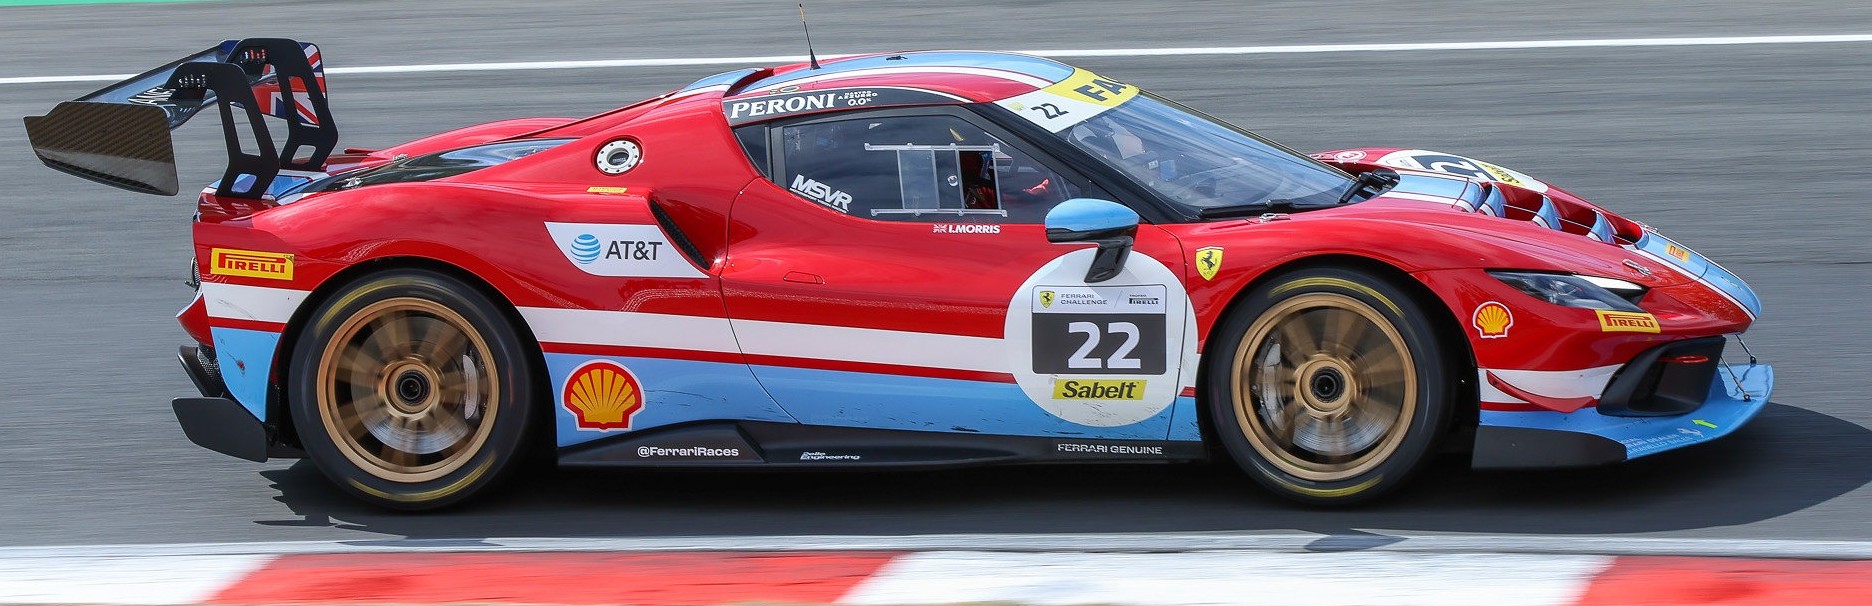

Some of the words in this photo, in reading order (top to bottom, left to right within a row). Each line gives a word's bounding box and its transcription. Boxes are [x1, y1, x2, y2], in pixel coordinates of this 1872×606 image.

[730, 93, 836, 119] PERONI
[1030, 103, 1070, 120] 22
[790, 174, 853, 212] MSVR
[948, 224, 1001, 234] I.MORRIS
[605, 240, 663, 260] AT&T
[217, 252, 287, 274] PIRELLI
[1128, 297, 1159, 305] PIRELLI
[1602, 313, 1655, 328] PIRELLI
[1067, 321, 1141, 369] 22
[1062, 380, 1137, 399] Sabelt
[637, 446, 740, 458] @FerrariRaces
[1057, 443, 1109, 453] FERRARI
[1110, 445, 1163, 455] GENUINE
